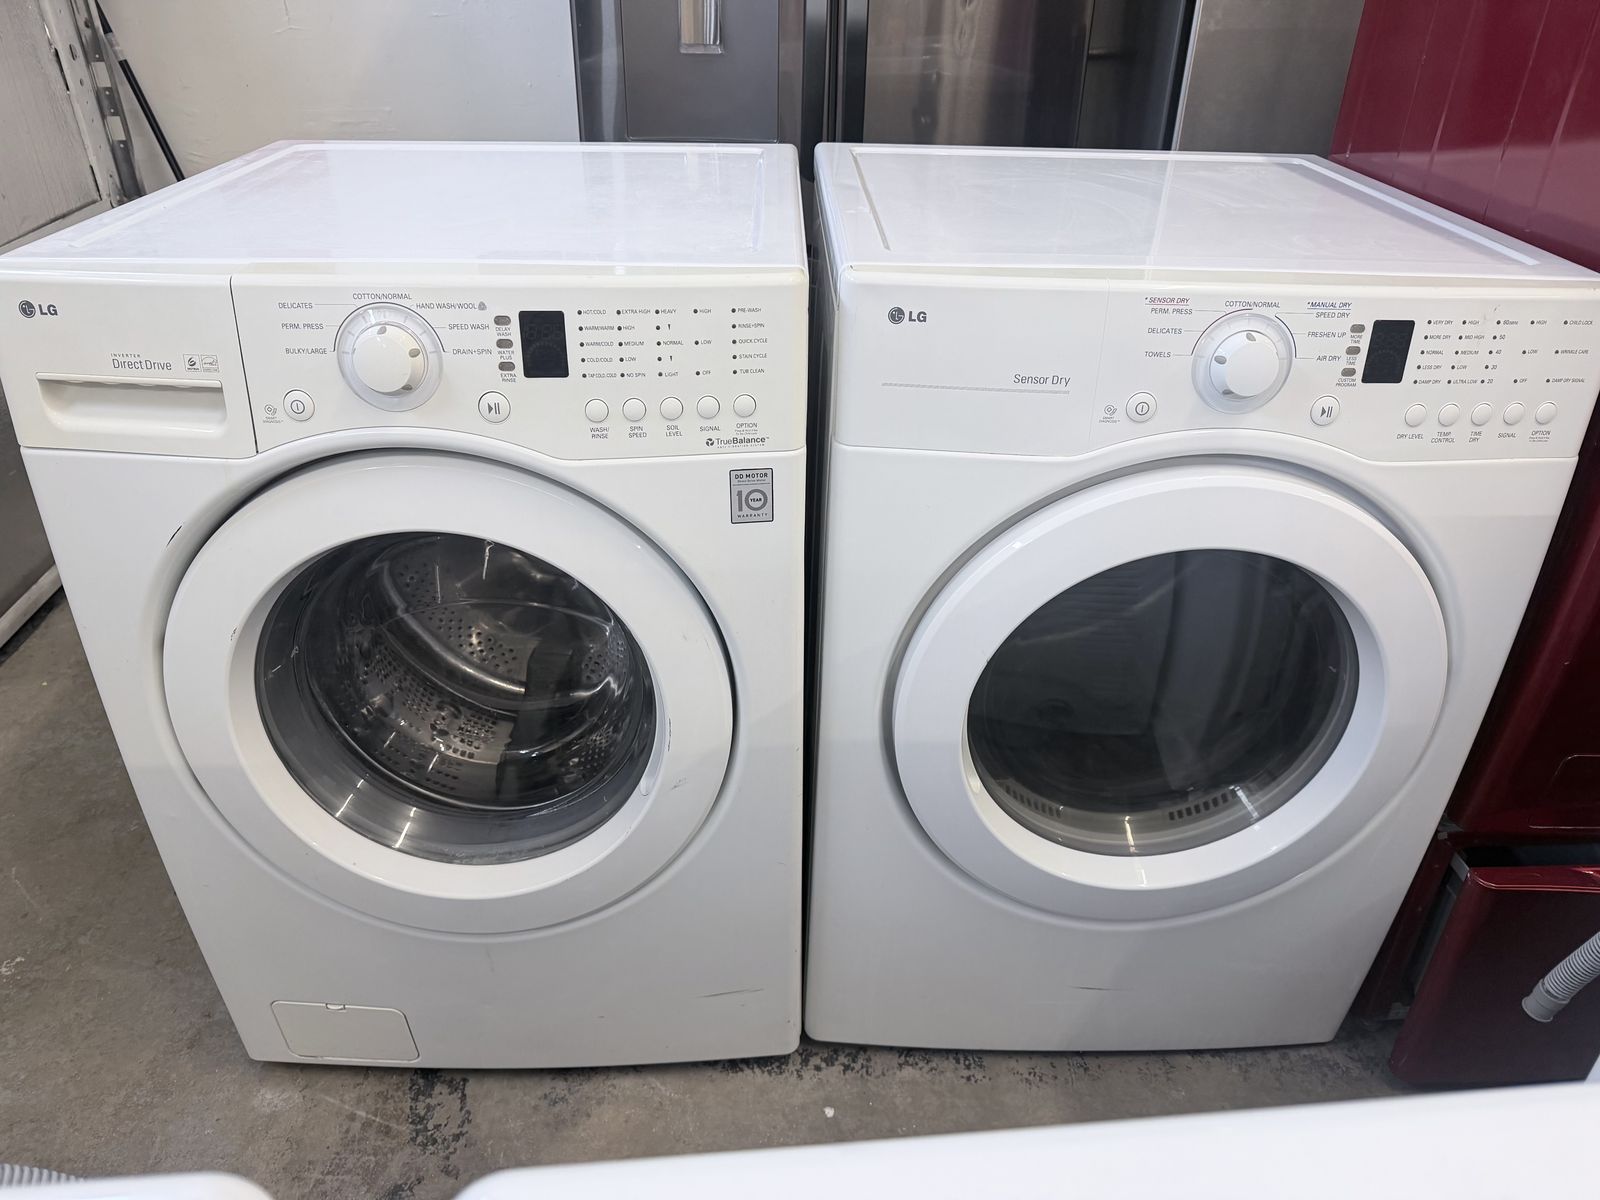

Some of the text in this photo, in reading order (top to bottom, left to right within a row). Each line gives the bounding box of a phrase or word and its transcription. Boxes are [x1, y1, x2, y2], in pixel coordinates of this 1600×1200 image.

[38, 303, 58, 316] LG
[1224, 300, 1281, 308] COTTON/NORMAL
[908, 310, 927, 323] LG
[1147, 327, 1182, 335] DELICATES
[112, 358, 172, 371] Direct Drive
[1013, 373, 1071, 388] Sensor Dry
[736, 488, 768, 512] 10
